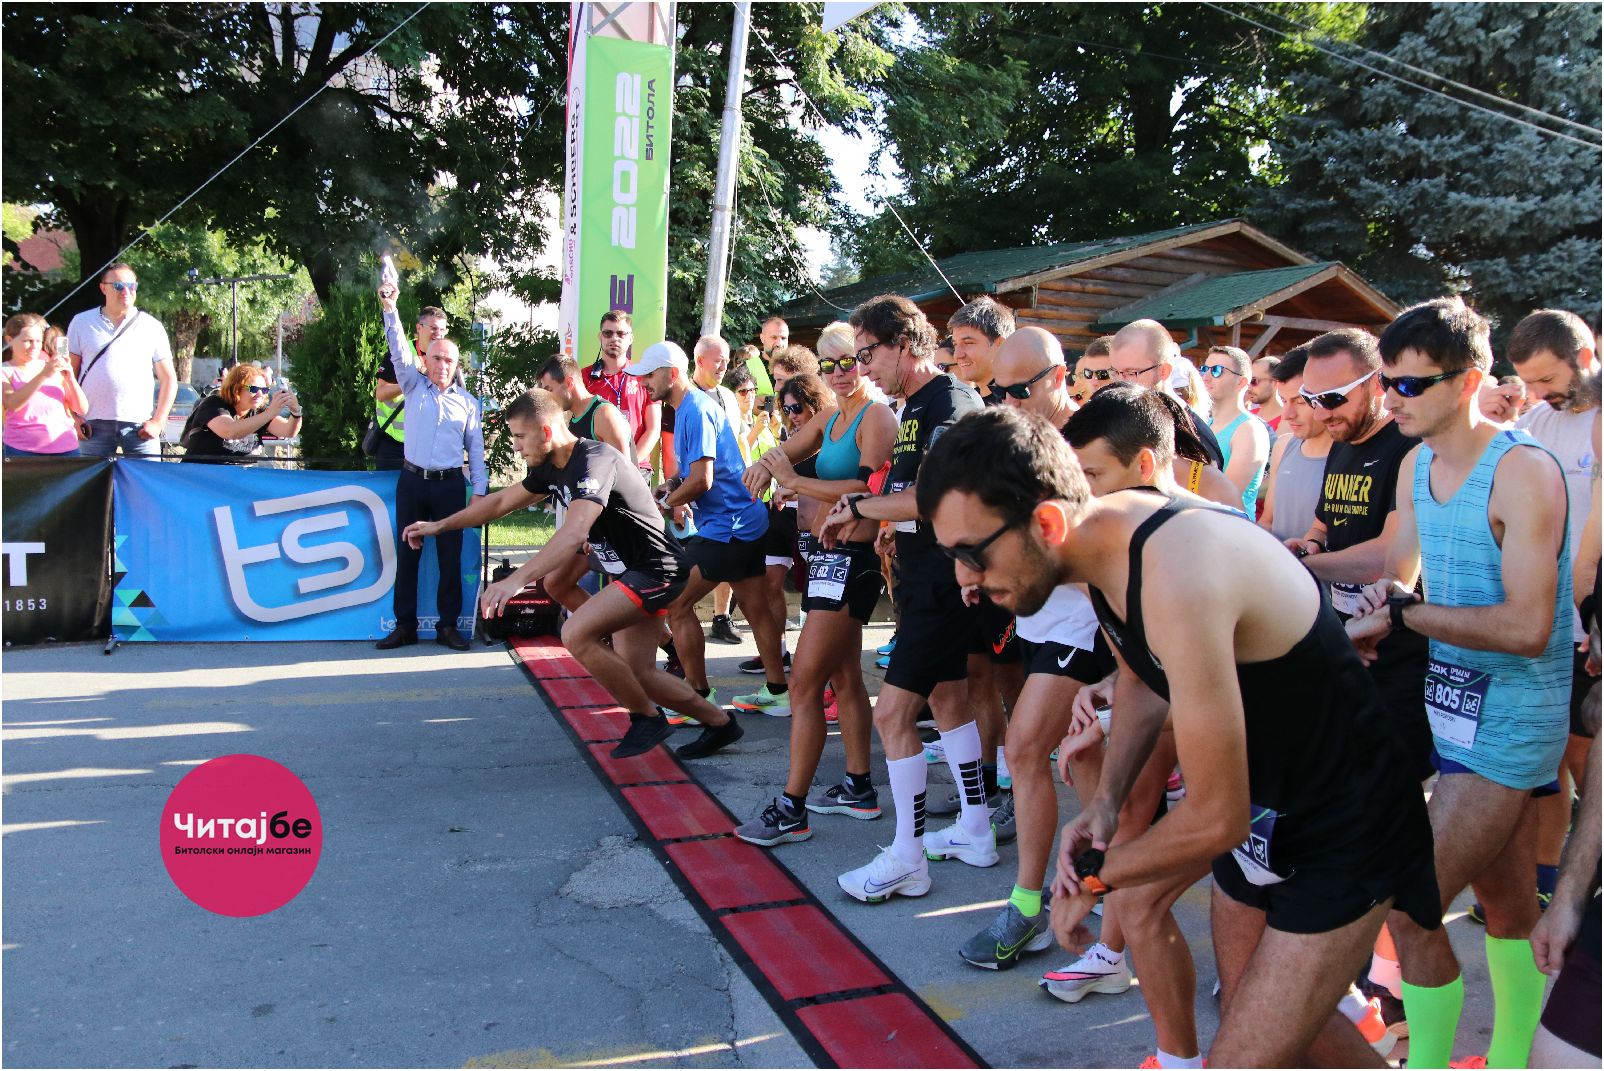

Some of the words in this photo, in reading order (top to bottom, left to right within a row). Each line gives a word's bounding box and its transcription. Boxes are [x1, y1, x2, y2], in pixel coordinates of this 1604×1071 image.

[645, 78, 656, 160] БИТОЛА
[611, 72, 641, 249] 2022
[4, 598, 47, 612] 1853
[1434, 683, 1462, 710] 805
